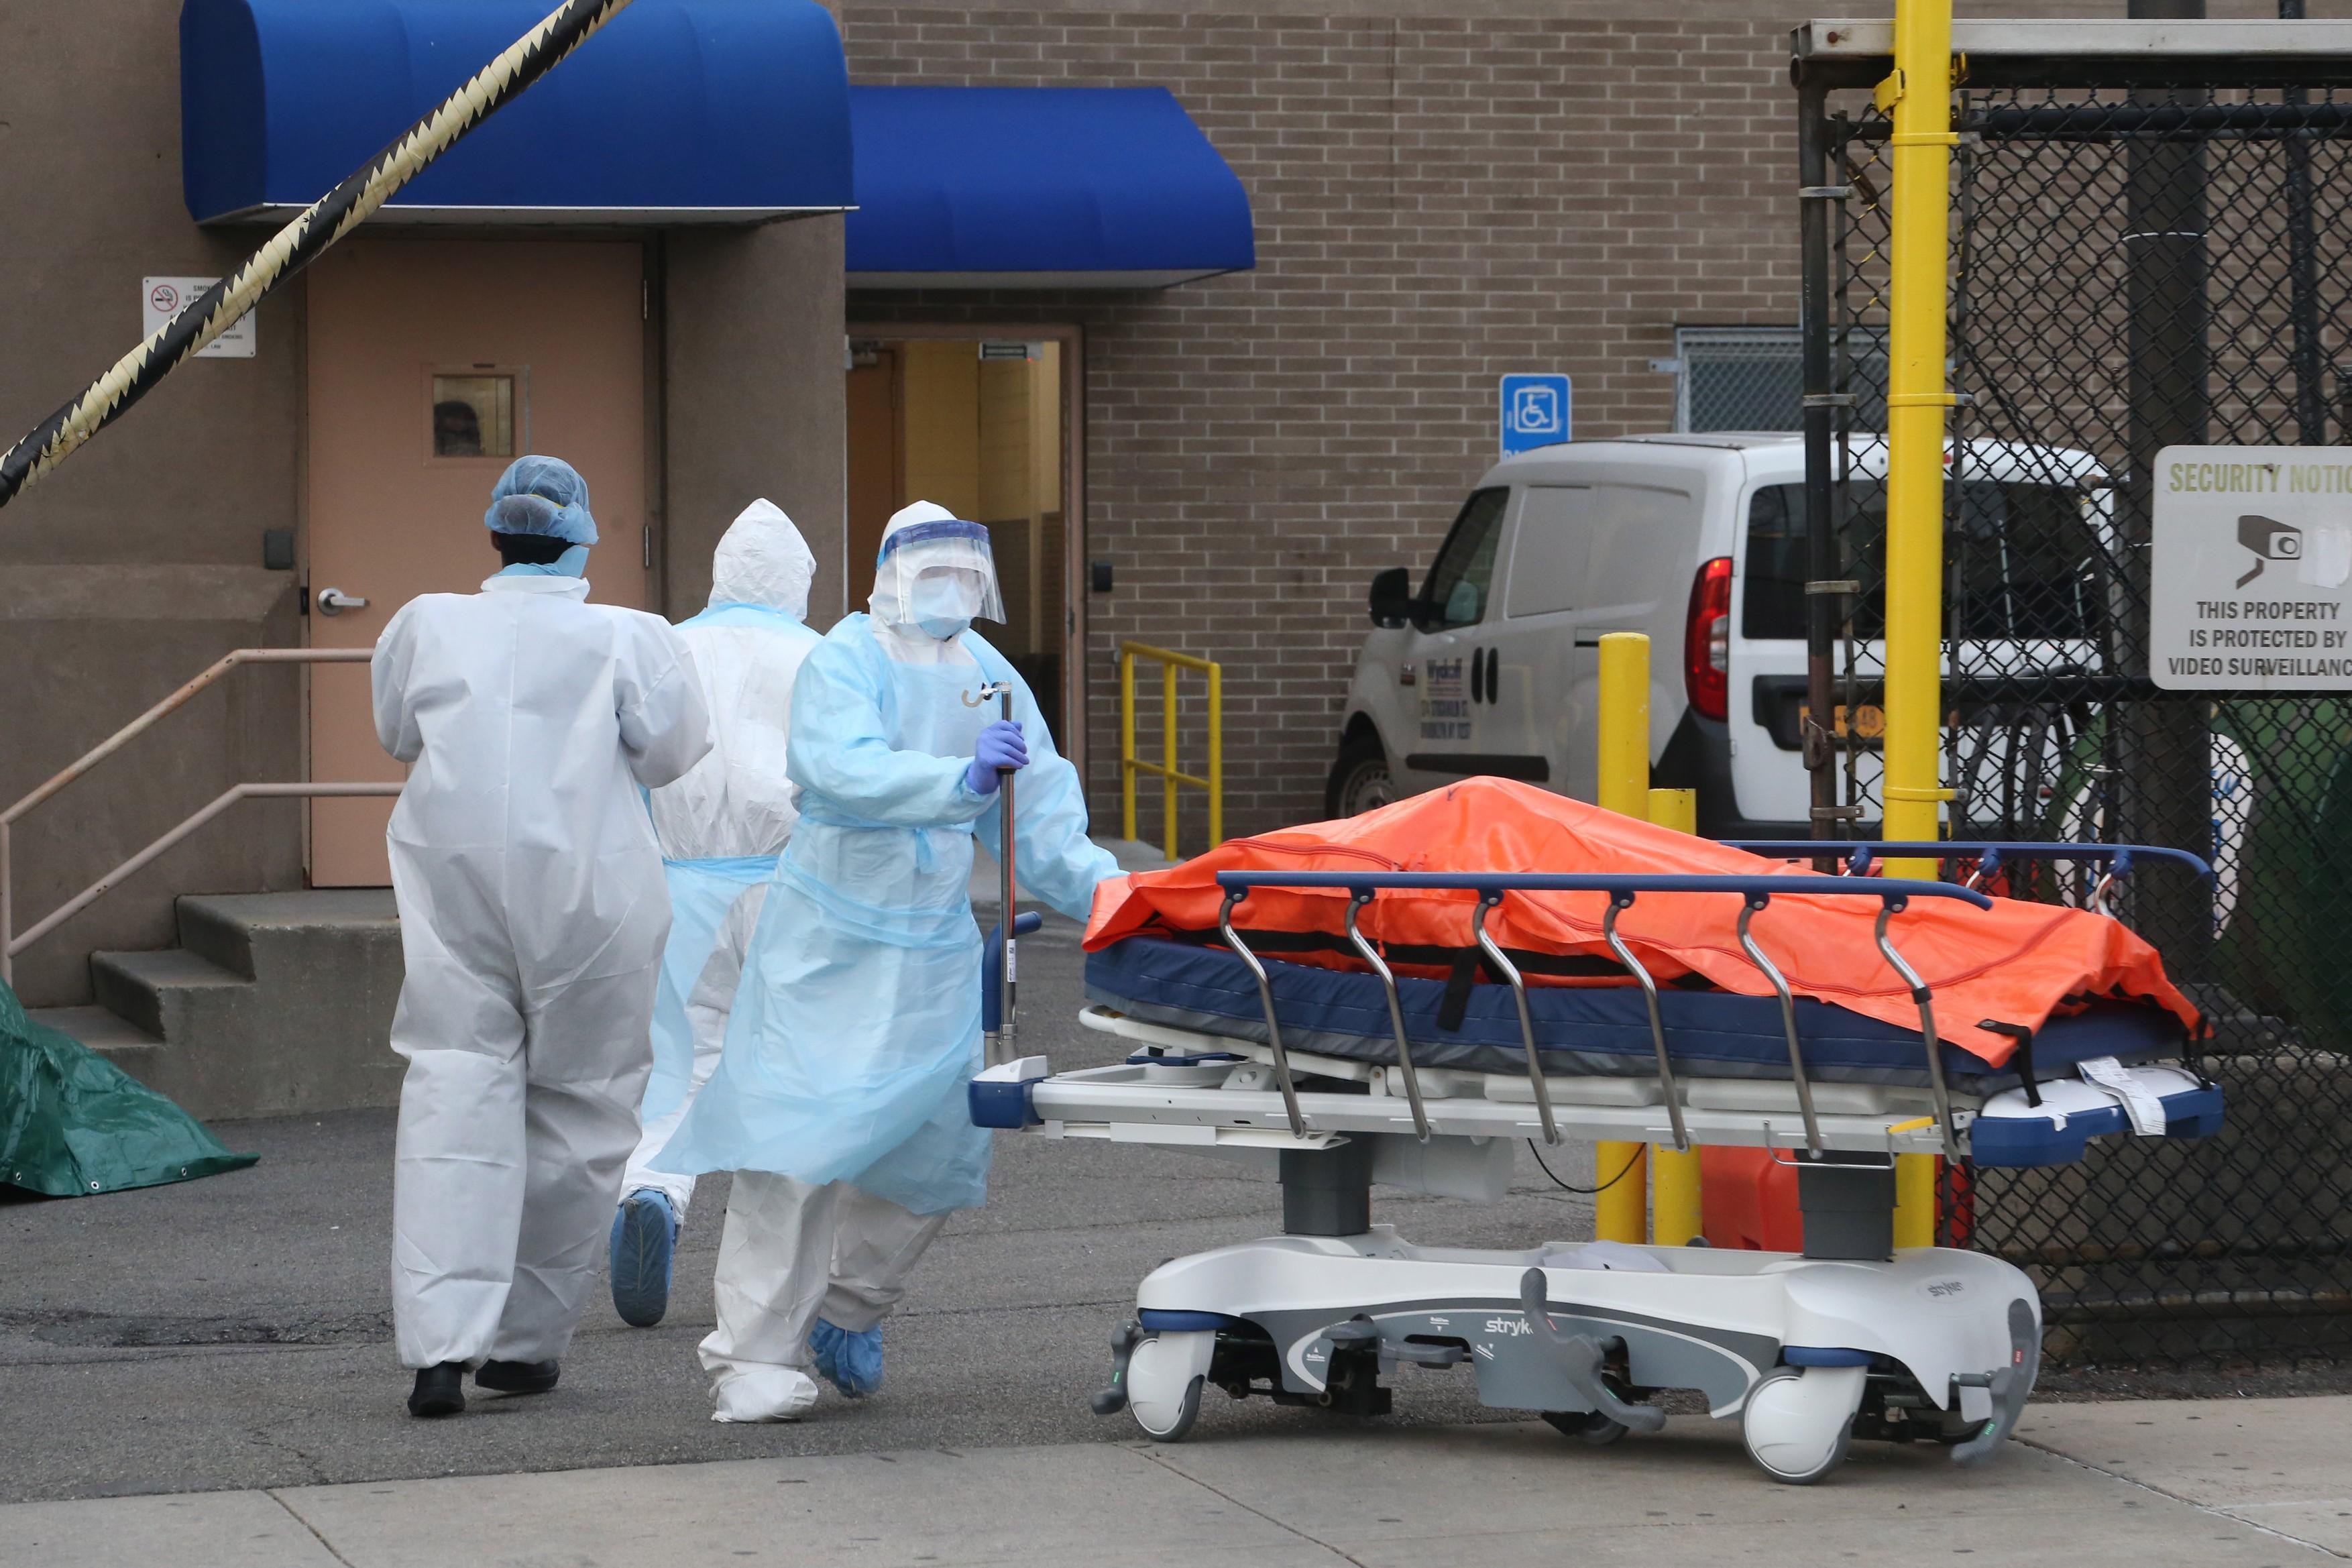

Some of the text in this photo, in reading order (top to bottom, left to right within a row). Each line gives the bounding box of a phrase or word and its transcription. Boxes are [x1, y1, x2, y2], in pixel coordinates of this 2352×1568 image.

[2170, 463, 2282, 493] SECURITY
[2196, 601, 2341, 620] THIS PROPERTY
[2189, 629, 2347, 649] IS PROTECTED BY
[2168, 657, 2222, 675] VIDEO
[1484, 1317, 1534, 1336] stryk
